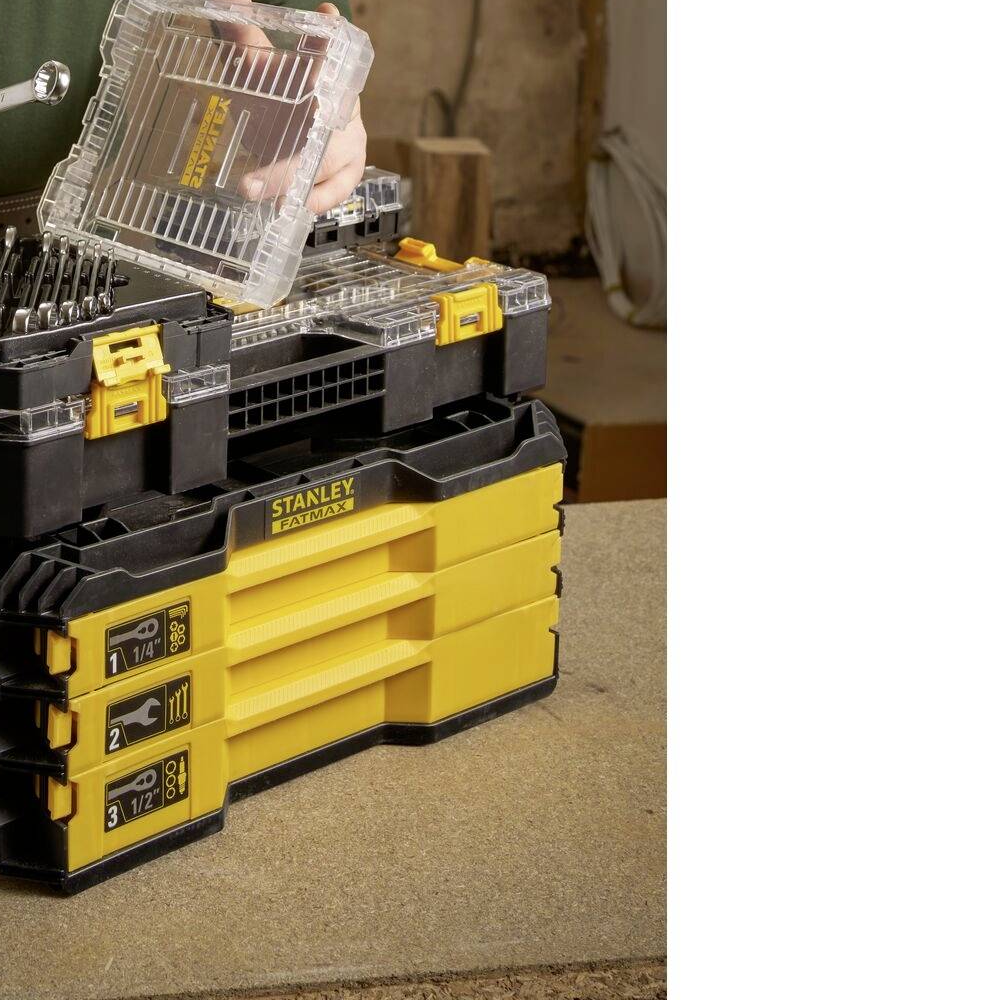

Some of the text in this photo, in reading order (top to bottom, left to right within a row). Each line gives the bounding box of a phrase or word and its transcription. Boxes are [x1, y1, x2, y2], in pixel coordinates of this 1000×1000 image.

[272, 477, 354, 518] STANLEY
[280, 500, 348, 530] FATMAX
[109, 652, 118, 674] 1
[109, 727, 120, 751] 2
[107, 805, 118, 828] 3
